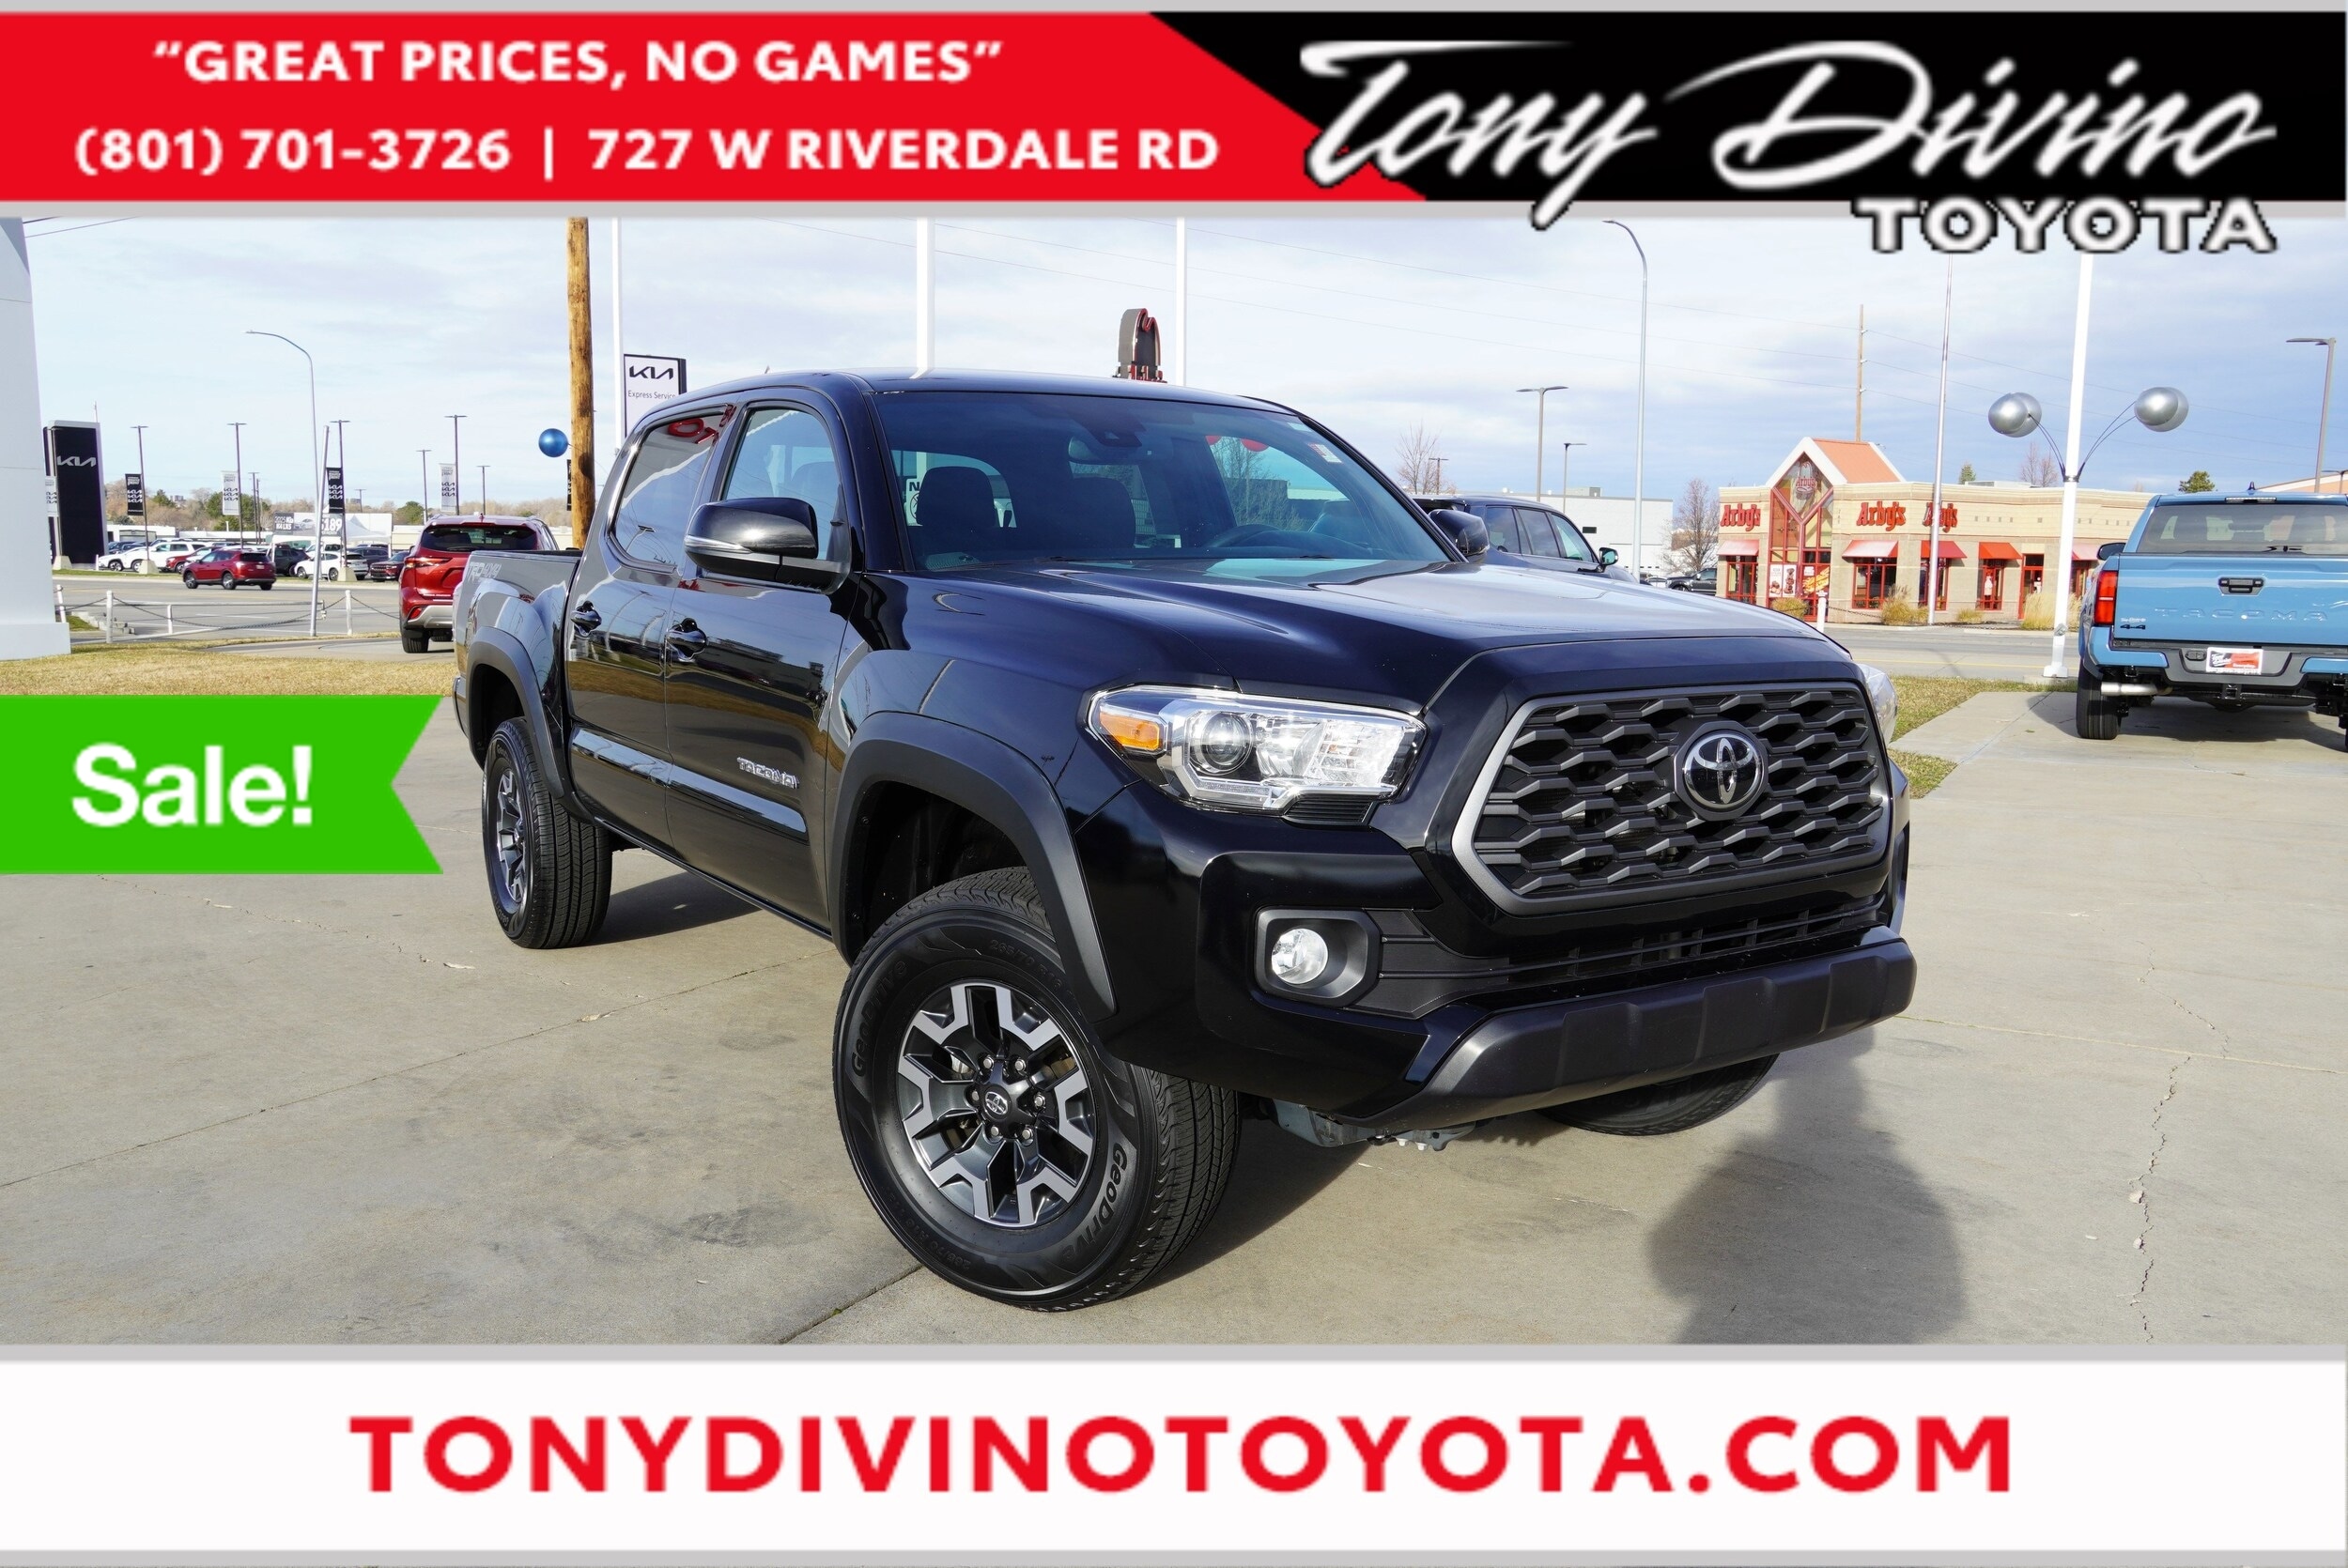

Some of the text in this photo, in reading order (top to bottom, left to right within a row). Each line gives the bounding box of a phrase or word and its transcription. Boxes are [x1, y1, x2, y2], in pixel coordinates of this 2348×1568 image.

[627, 390, 653, 400] Express
[1720, 502, 1761, 531] Arby's
[1856, 500, 1907, 531] Arby's
[2154, 607, 2327, 623] TACOMA
[736, 757, 799, 789] TACOMA
